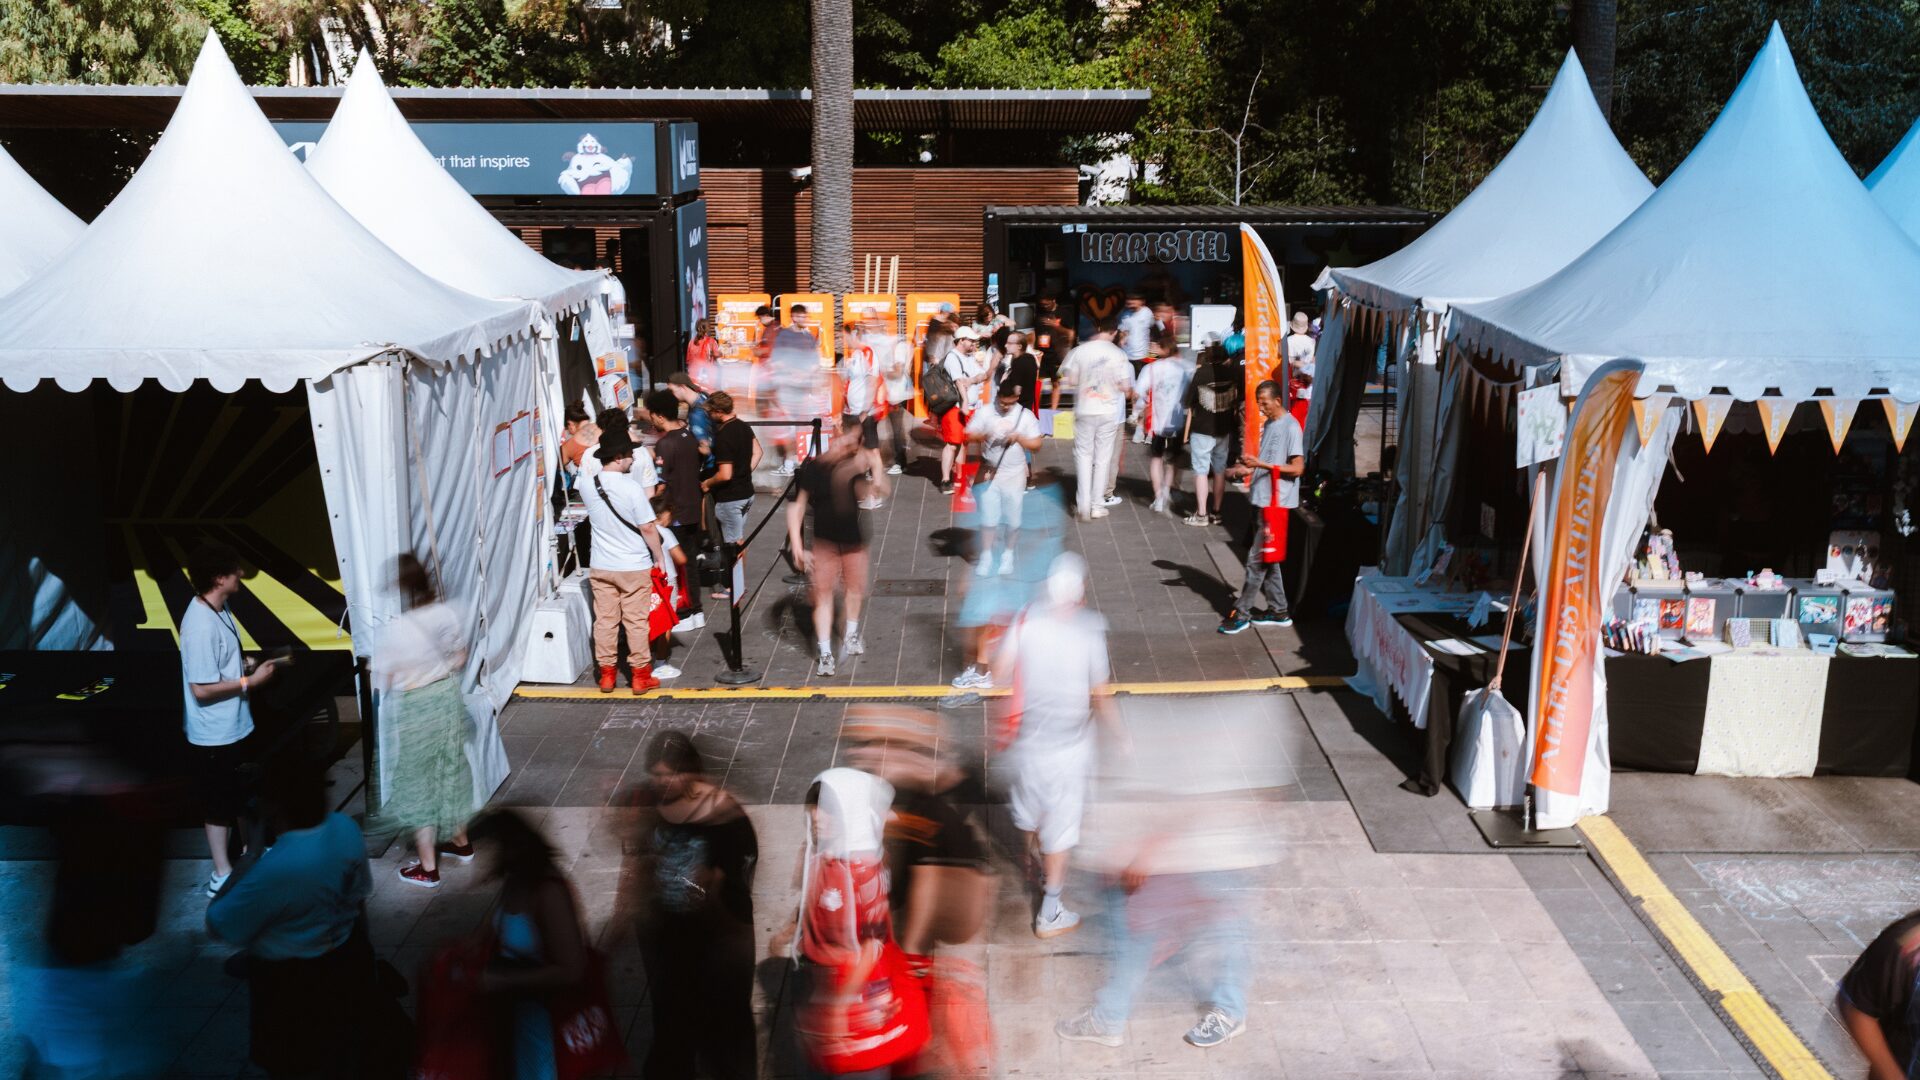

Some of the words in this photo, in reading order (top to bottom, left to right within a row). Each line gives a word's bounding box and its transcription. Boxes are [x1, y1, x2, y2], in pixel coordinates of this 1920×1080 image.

[450, 154, 476, 168] that
[480, 154, 530, 171] inspires
[1081, 230, 1231, 263] HEARTSTEEL
[1564, 443, 1600, 599] ARTISTES
[1553, 605, 1579, 668] DES
